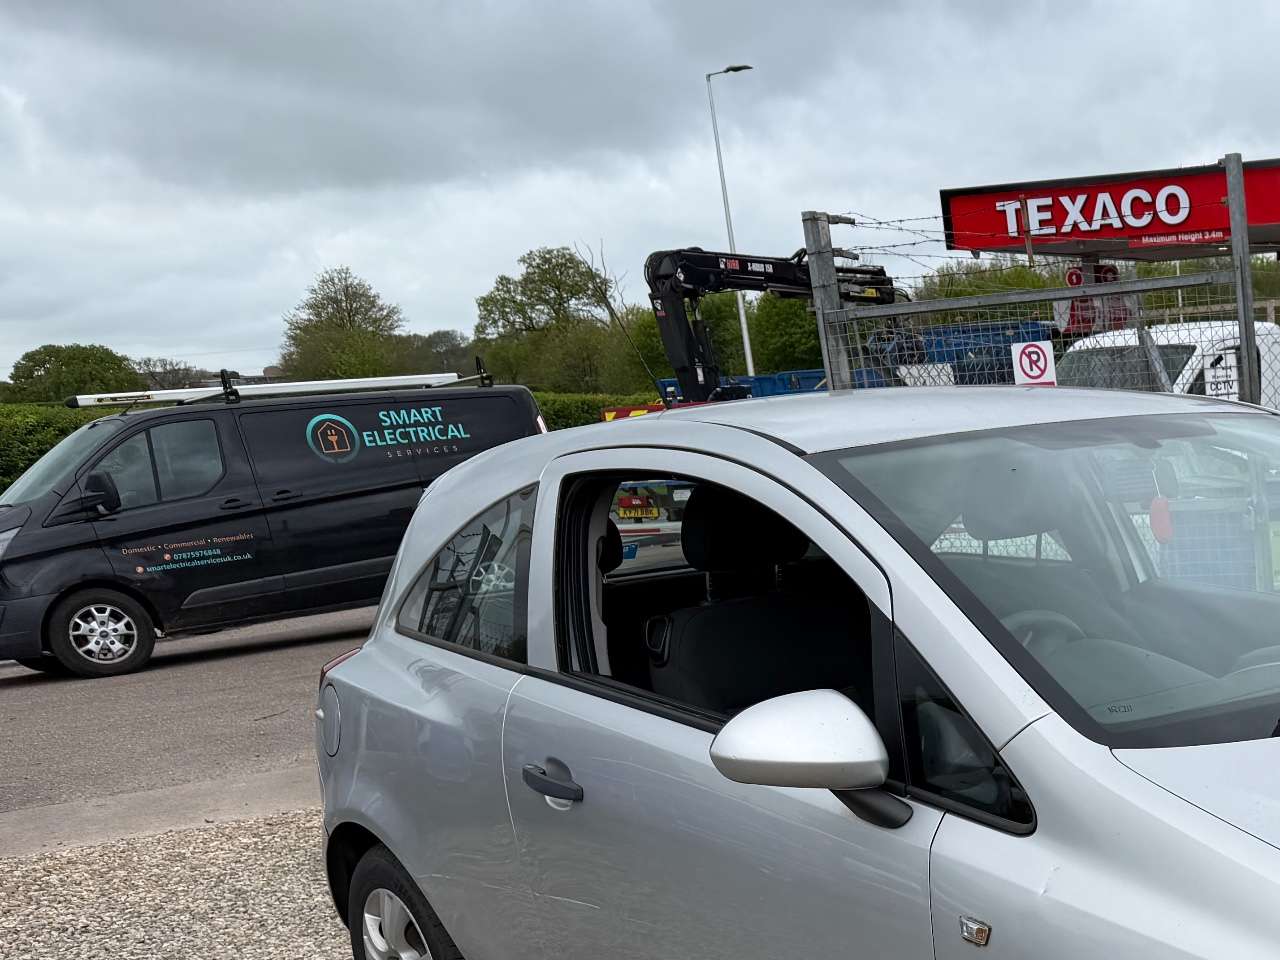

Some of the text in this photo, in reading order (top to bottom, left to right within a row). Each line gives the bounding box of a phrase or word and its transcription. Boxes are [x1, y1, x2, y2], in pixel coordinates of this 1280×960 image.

[996, 184, 1190, 237] TEXACO
[1142, 230, 1223, 244] Maximum Height 3.4m
[1210, 380, 1234, 392] CCTV
[378, 406, 443, 427] SMART
[362, 423, 471, 448] ELECTRICAL
[387, 445, 458, 458] SERVICES
[122, 533, 254, 555] Domestic Commercial Renewables
[146, 552, 253, 572] smartelectricalservicesuk.co.uk
